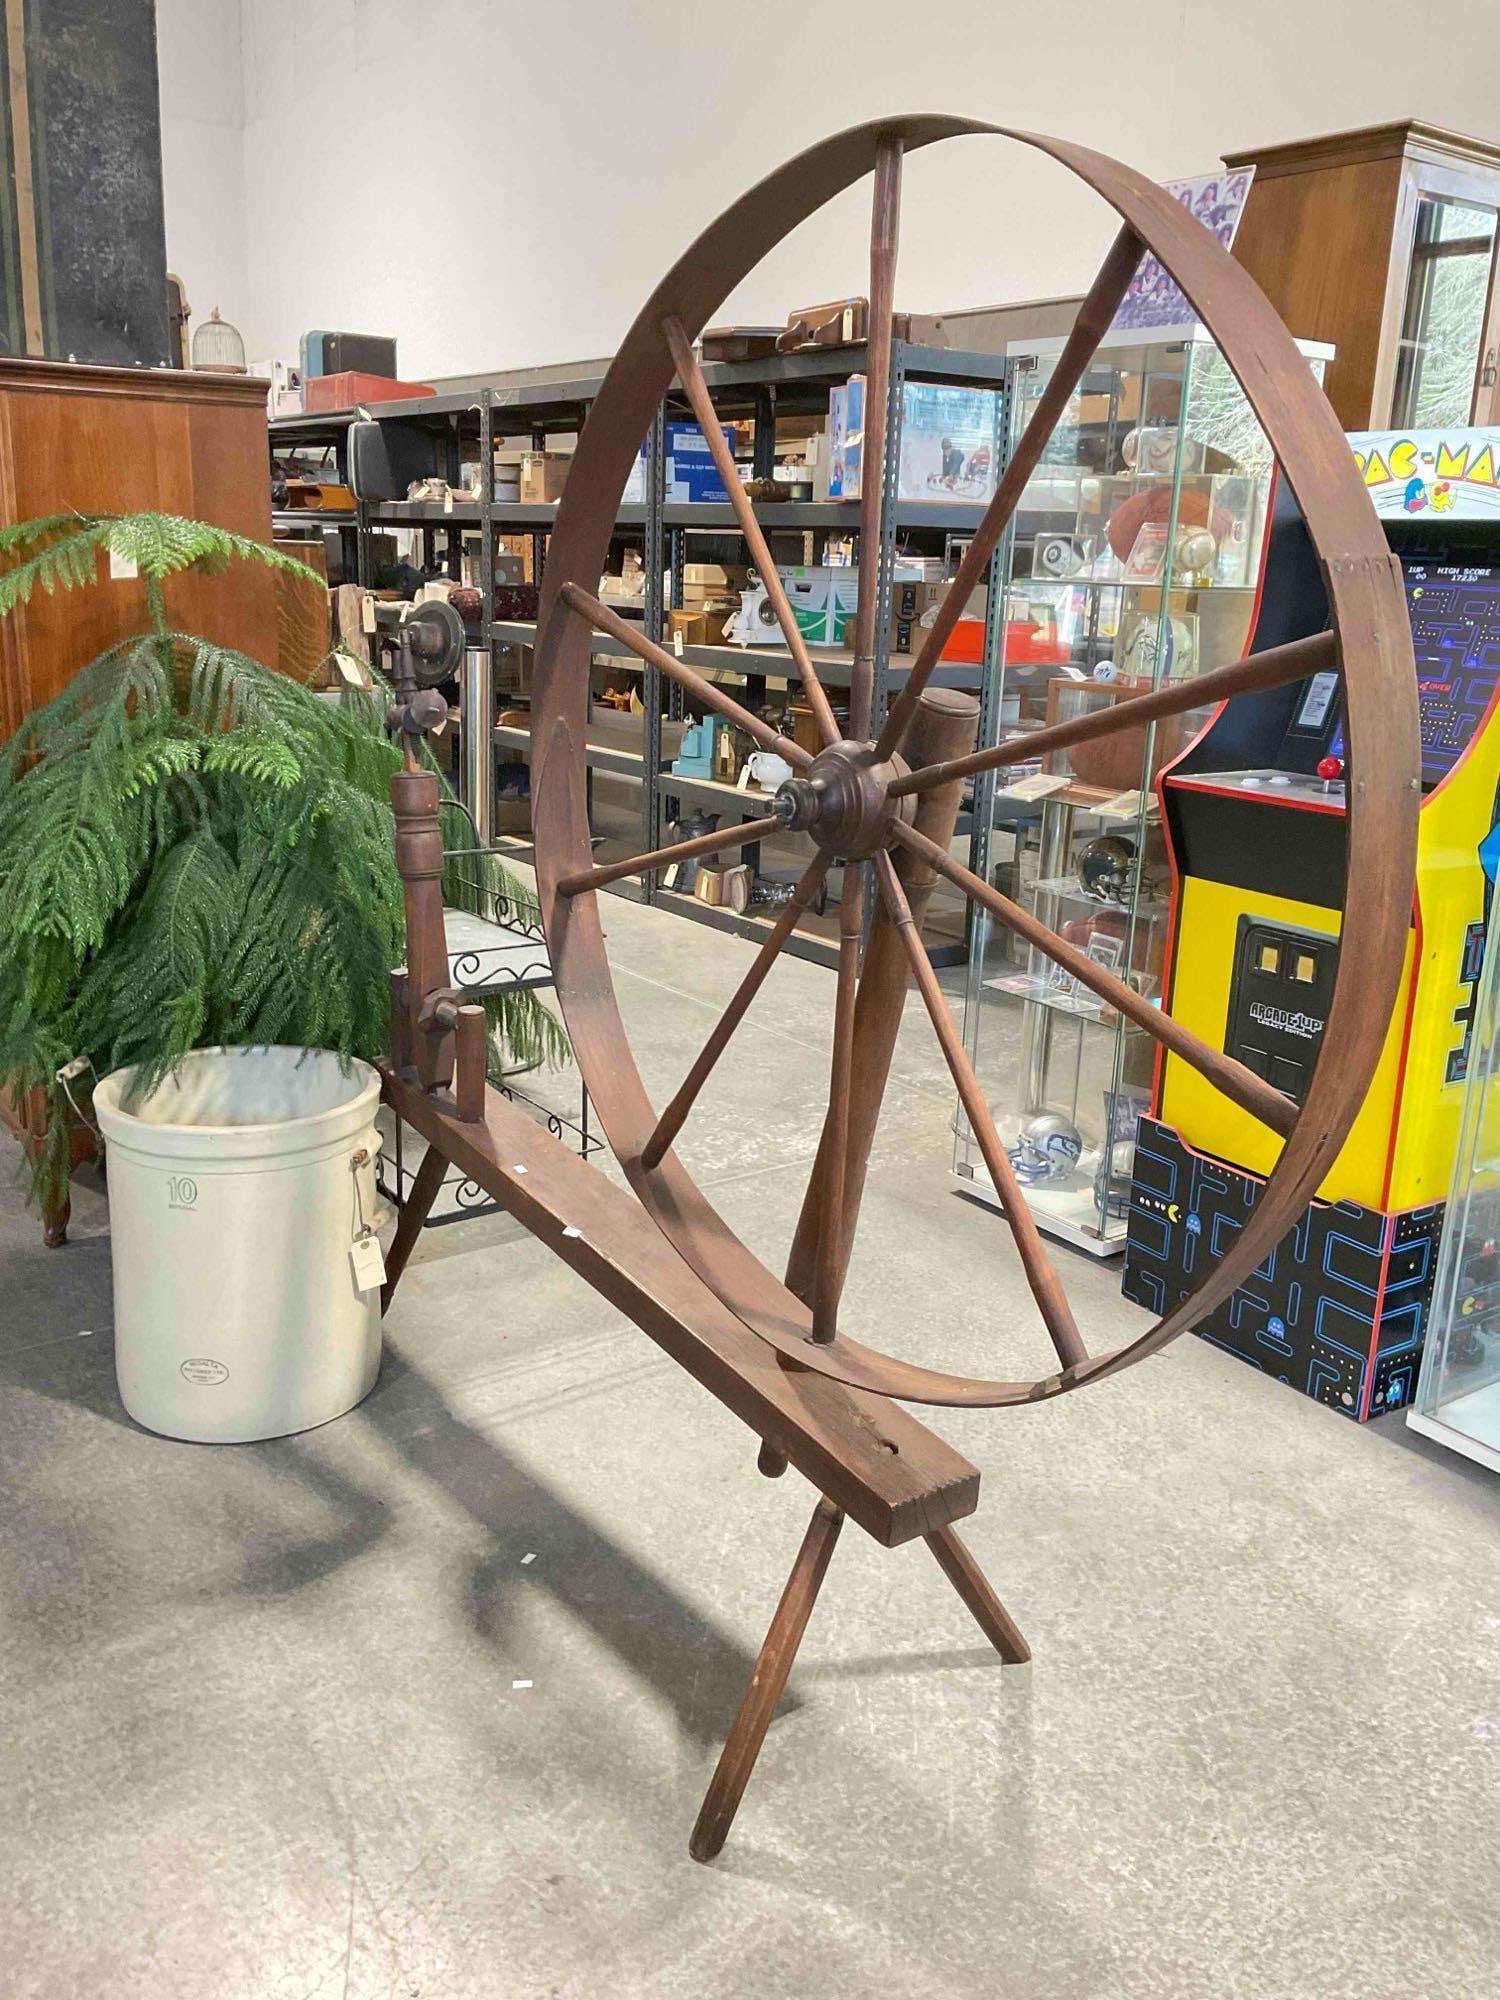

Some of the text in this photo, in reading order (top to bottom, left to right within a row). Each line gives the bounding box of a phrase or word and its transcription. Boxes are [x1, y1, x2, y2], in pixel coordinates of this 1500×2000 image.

[1353, 439, 1500, 489] AC-MA
[1408, 566, 1424, 574] 1UP
[1437, 567, 1492, 576] HIGH SCORE
[1257, 1018, 1313, 1040] LEGACY EDITION
[166, 1176, 198, 1204] 10
